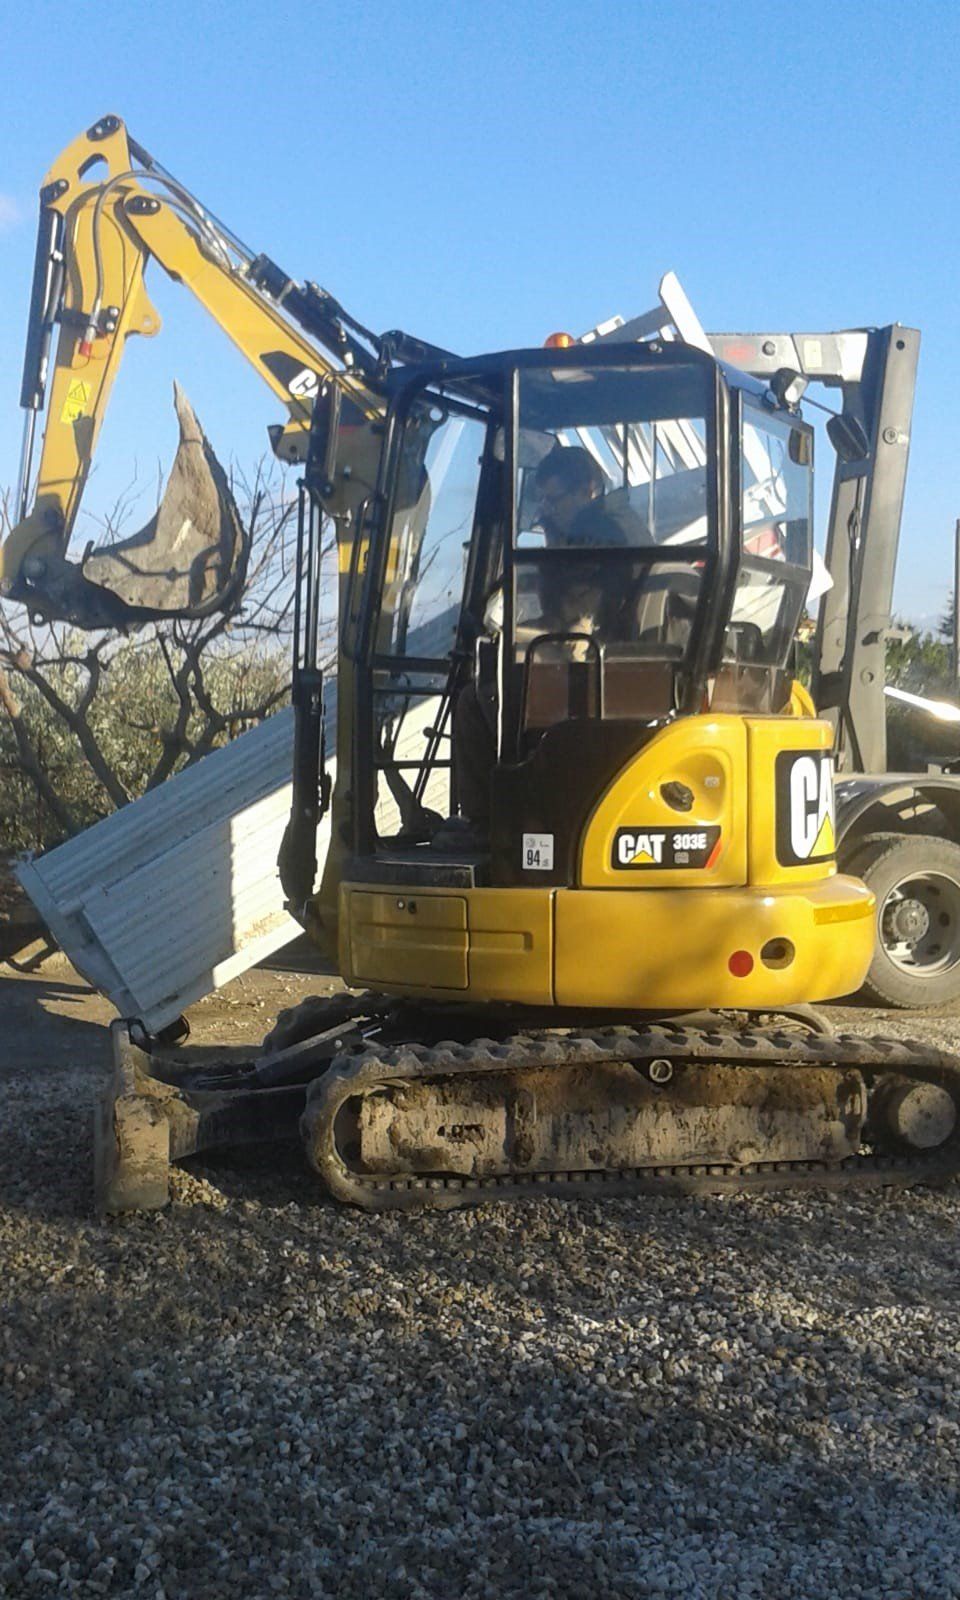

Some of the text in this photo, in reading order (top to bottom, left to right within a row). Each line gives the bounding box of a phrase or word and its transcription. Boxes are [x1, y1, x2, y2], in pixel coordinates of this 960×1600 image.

[288, 369, 328, 397] CA
[790, 756, 835, 858] CA
[618, 833, 666, 864] CAT
[672, 832, 708, 850] 303E
